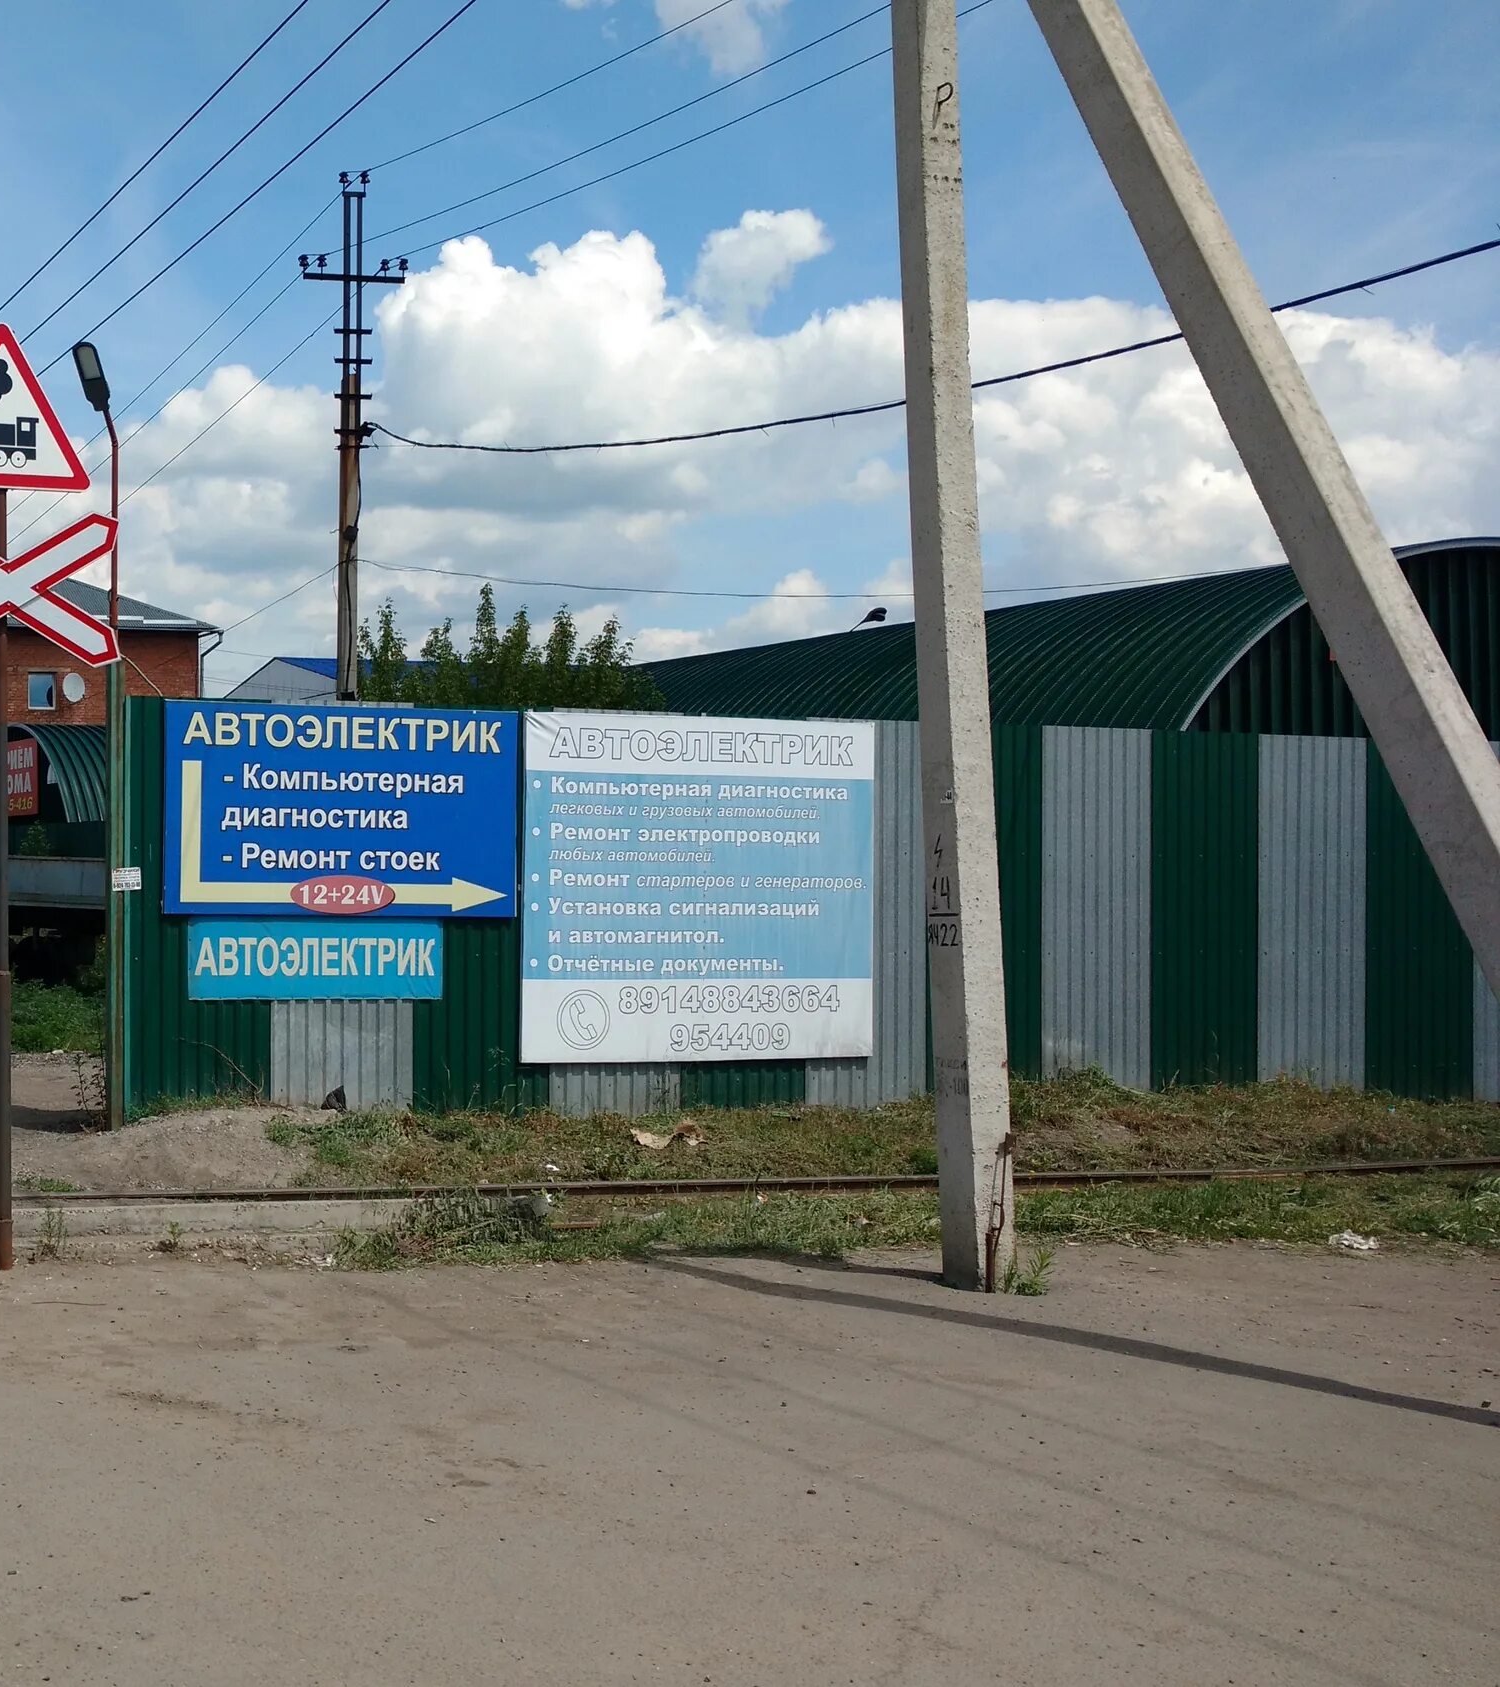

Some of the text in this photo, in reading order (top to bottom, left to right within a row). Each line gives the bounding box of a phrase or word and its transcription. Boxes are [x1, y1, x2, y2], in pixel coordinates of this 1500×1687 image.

[182, 711, 502, 754] АВТОЭЛЕКТРИК
[8, 746, 33, 770] ИЁМ
[549, 727, 853, 766] АВТОЭЛЕКТРИК
[8, 772, 32, 794] ОМА
[242, 763, 464, 798] Компьютерная
[551, 776, 848, 801] Компьютерная диагностика
[221, 806, 408, 831] диагностика
[549, 802, 821, 821] легковых и грузовых автомобилей.
[550, 823, 820, 846] Ремонт электропроводки
[242, 843, 351, 871] Ремонт
[359, 850, 440, 871] стоек
[549, 847, 715, 863] любых автомобилей.
[549, 869, 867, 893] Ремонт стартеров и генераторов.
[932, 876, 950, 910] 14
[299, 884, 385, 905] 12+24V
[549, 898, 820, 919] Установка сигнализаций
[549, 930, 724, 948] и автомагнитол.
[194, 937, 436, 977] АВТОЭЛЕКТРИК
[548, 954, 784, 976] Отчётные документы.
[618, 984, 840, 1014] 89148843664
[670, 1023, 790, 1052] 954409
